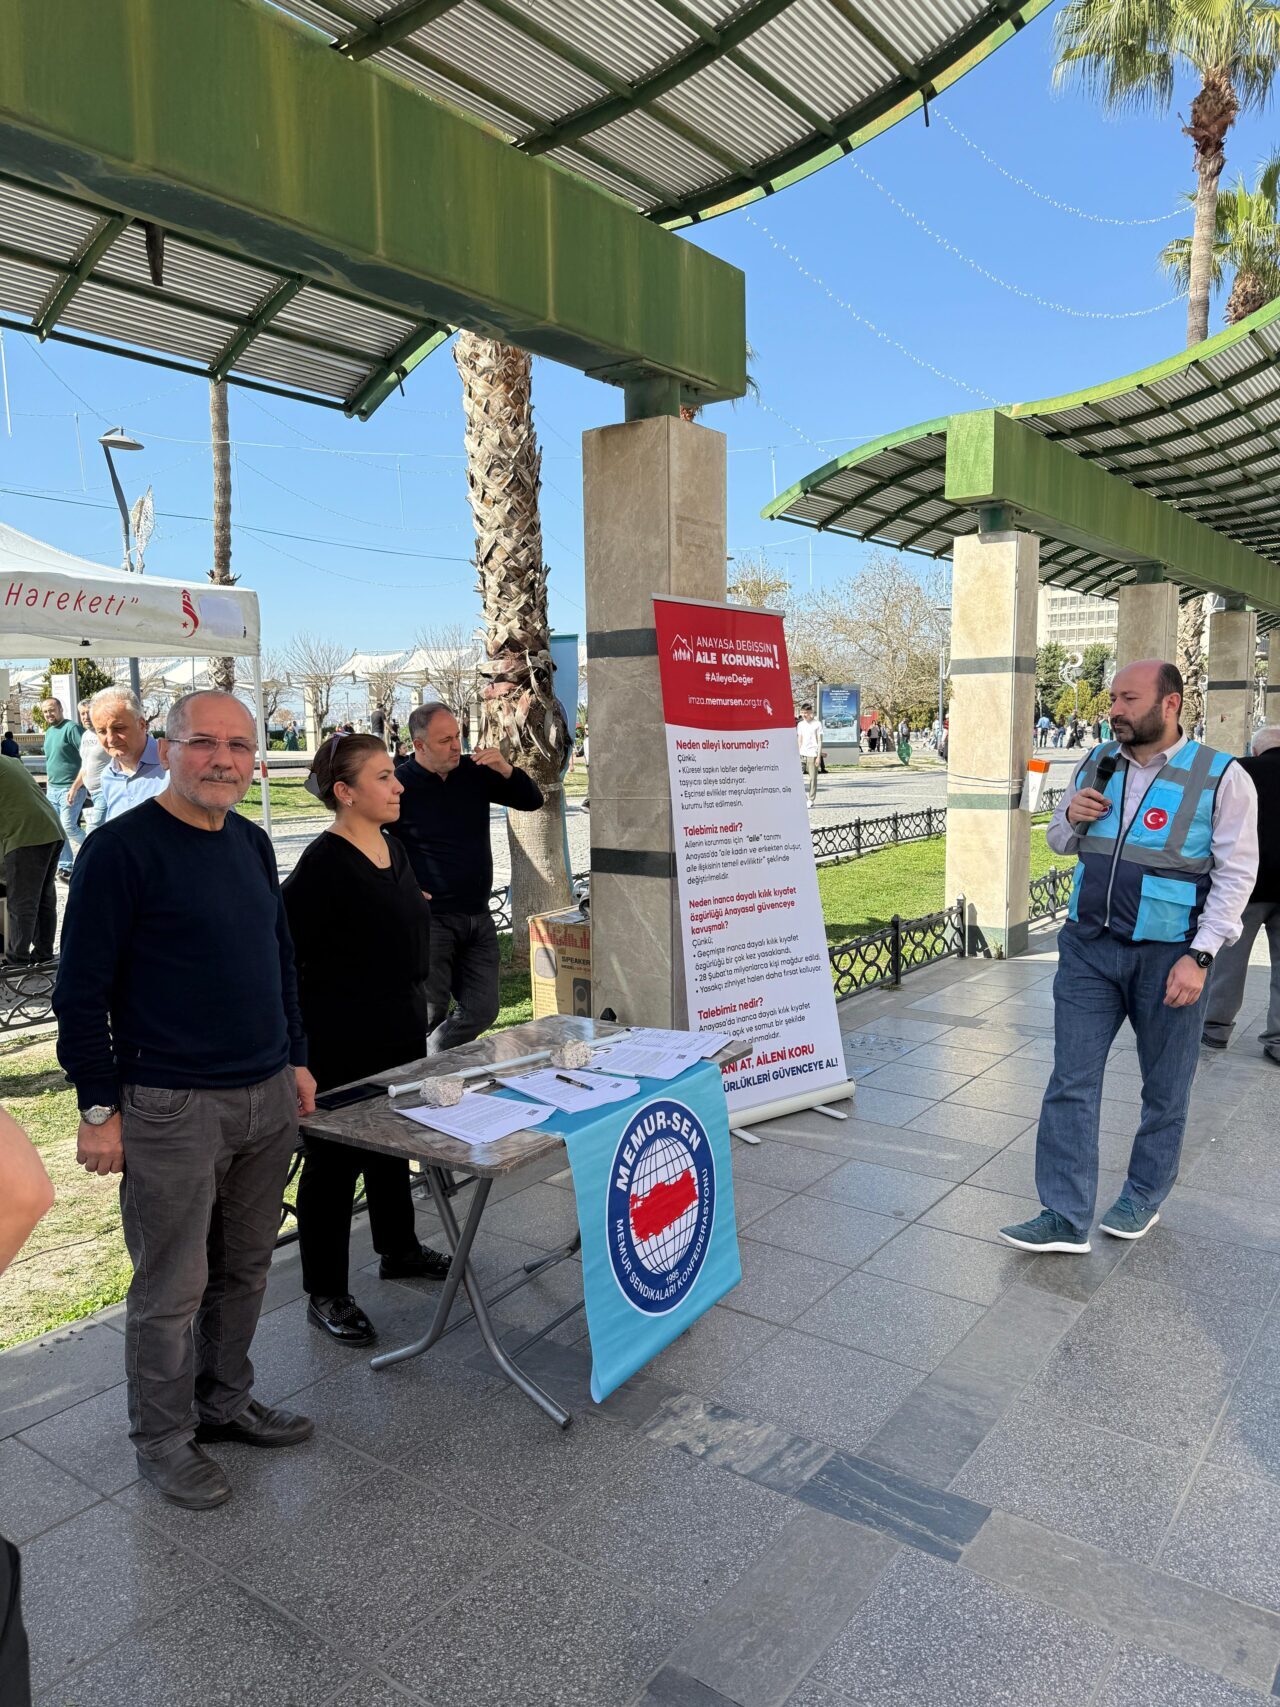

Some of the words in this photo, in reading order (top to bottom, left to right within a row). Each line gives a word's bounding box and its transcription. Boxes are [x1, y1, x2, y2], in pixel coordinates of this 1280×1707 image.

[697, 636, 734, 650] ANAYASA
[696, 651, 717, 664] AİLE
[705, 672, 753, 686] #AileyeDeğer
[688, 695, 762, 708] imza.memursen.org.tr
[676, 740, 700, 750] Neden
[702, 741, 720, 752] aileyi
[722, 740, 769, 751] korumalıyız?
[740, 765, 779, 773] değerlerimizin
[684, 790, 706, 799] Eşcinsel
[681, 802, 702, 810] kurumu
[684, 825, 718, 836] Talebimiz
[720, 823, 743, 834] nedir?
[685, 840, 704, 849] Ailenin
[698, 862, 720, 872] ilişkisinin
[767, 855, 789, 865] şeklinde
[689, 897, 712, 909] Neden
[713, 895, 734, 905] inanca
[736, 892, 756, 904] dayalı
[758, 889, 772, 898] kılık
[774, 887, 796, 897] kıyafet
[690, 909, 723, 923] özgürlüğü
[724, 905, 755, 917] Anayasal
[757, 900, 795, 913] güvenceye
[691, 920, 728, 935] kavuşmalı?
[697, 946, 725, 959] Geçmişte
[726, 943, 746, 953] inanca
[747, 938, 766, 950] dayalı
[766, 936, 778, 945] kılık
[779, 934, 799, 944] kıyafet
[695, 958, 725, 972] özgürlüğü
[734, 954, 745, 964] çok
[734, 960, 768, 974] milyonlarca
[769, 959, 780, 970] kişi
[780, 956, 804, 966] mağdur
[700, 982, 724, 994] Yasakçı
[724, 978, 746, 989] zihniyet
[747, 974, 764, 983] halen
[766, 971, 783, 980] daha
[784, 968, 798, 976] fırsat
[698, 1002, 737, 1020] Talebimiz
[739, 997, 764, 1011] nedir?
[736, 1014, 757, 1024] inanca
[758, 1010, 777, 1020] dayalı
[778, 1007, 790, 1015] kılık
[791, 1002, 810, 1013] kıyafet
[732, 1028, 745, 1038] açık
[754, 1021, 774, 1031] somut
[775, 1018, 783, 1026] bir
[785, 1014, 805, 1026] şekilde
[721, 1061, 738, 1075] ANI
[740, 1058, 754, 1070] AT,
[756, 1047, 786, 1067] AİLENİ
[788, 1044, 814, 1059] KORU
[723, 1070, 771, 1093] ÜRLÜKLERİ
[772, 1060, 824, 1080] GÜVENCEYE
[826, 1058, 838, 1068] AL!
[616, 1111, 701, 1192] MEMUR-SEN
[616, 1219, 631, 1274] MEMUR
[630, 1271, 677, 1301] SENDİKALARI
[677, 1168, 710, 1289] KONFEDERASYONU
[665, 1270, 680, 1285] 1995
